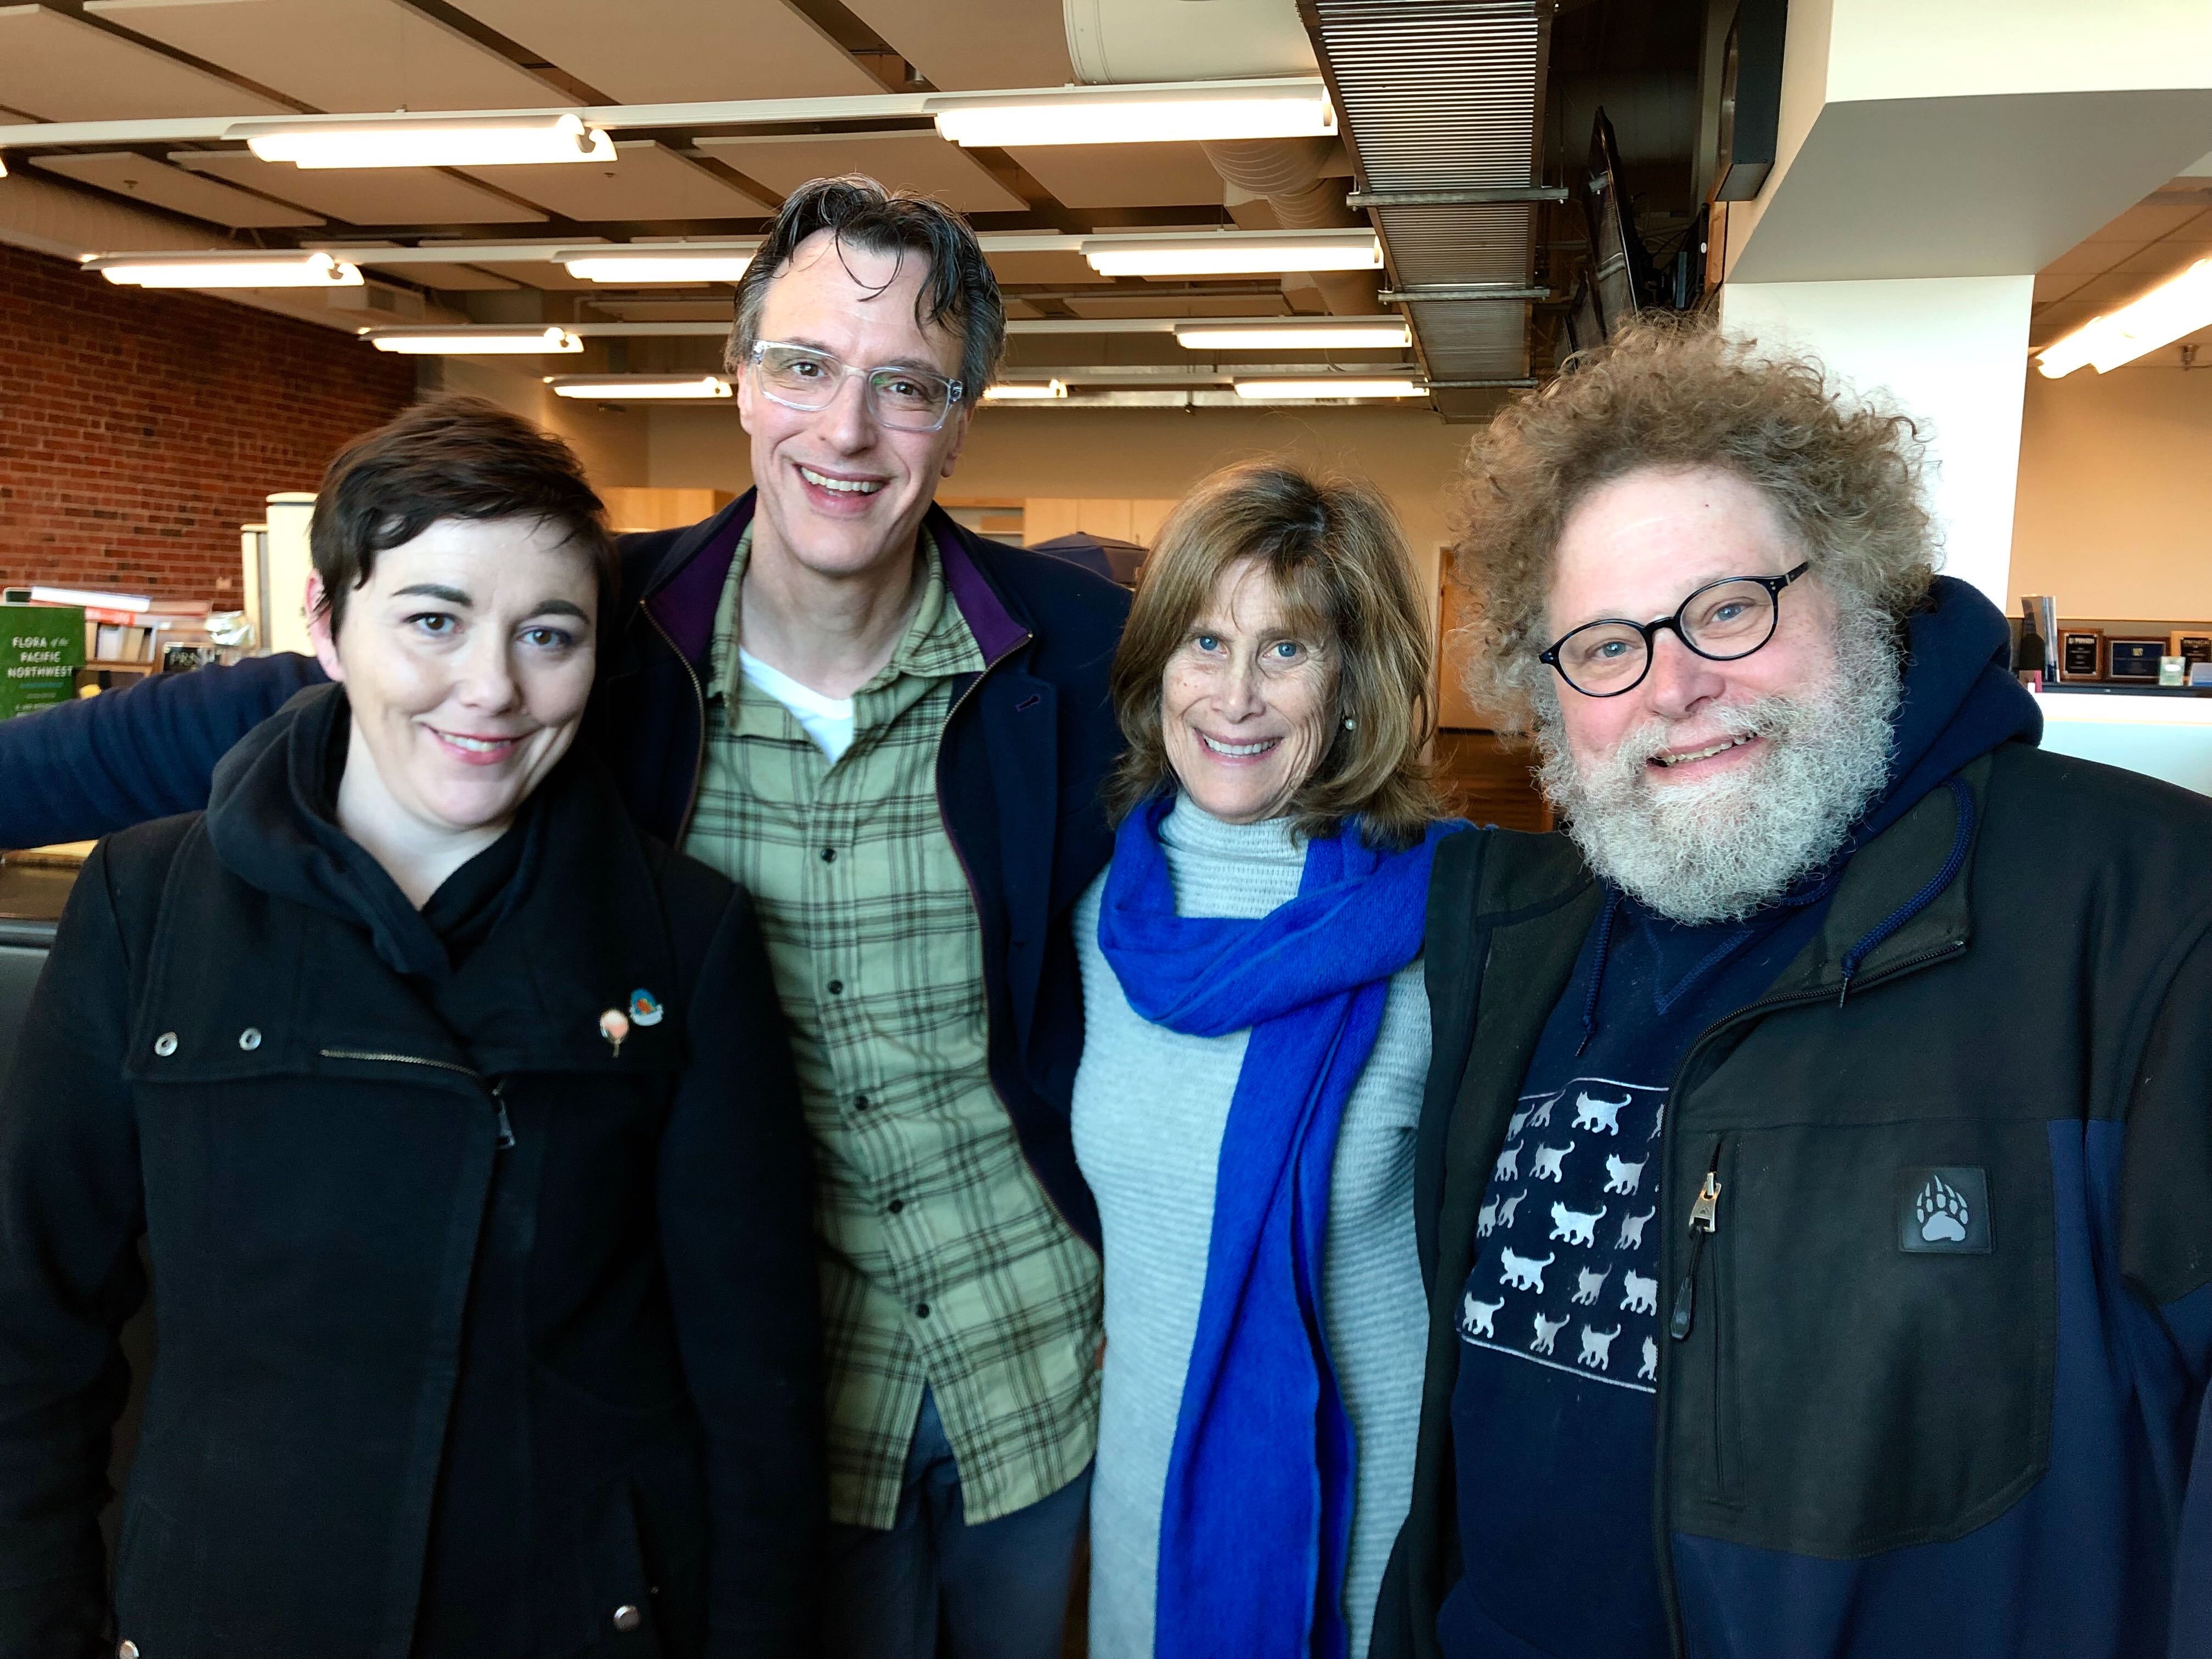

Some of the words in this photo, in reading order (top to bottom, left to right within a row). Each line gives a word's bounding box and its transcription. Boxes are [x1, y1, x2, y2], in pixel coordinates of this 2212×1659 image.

[12, 636, 47, 648] FLORA
[20, 651, 61, 663] PACIFIC
[7, 665, 73, 678] NORTHWEST
